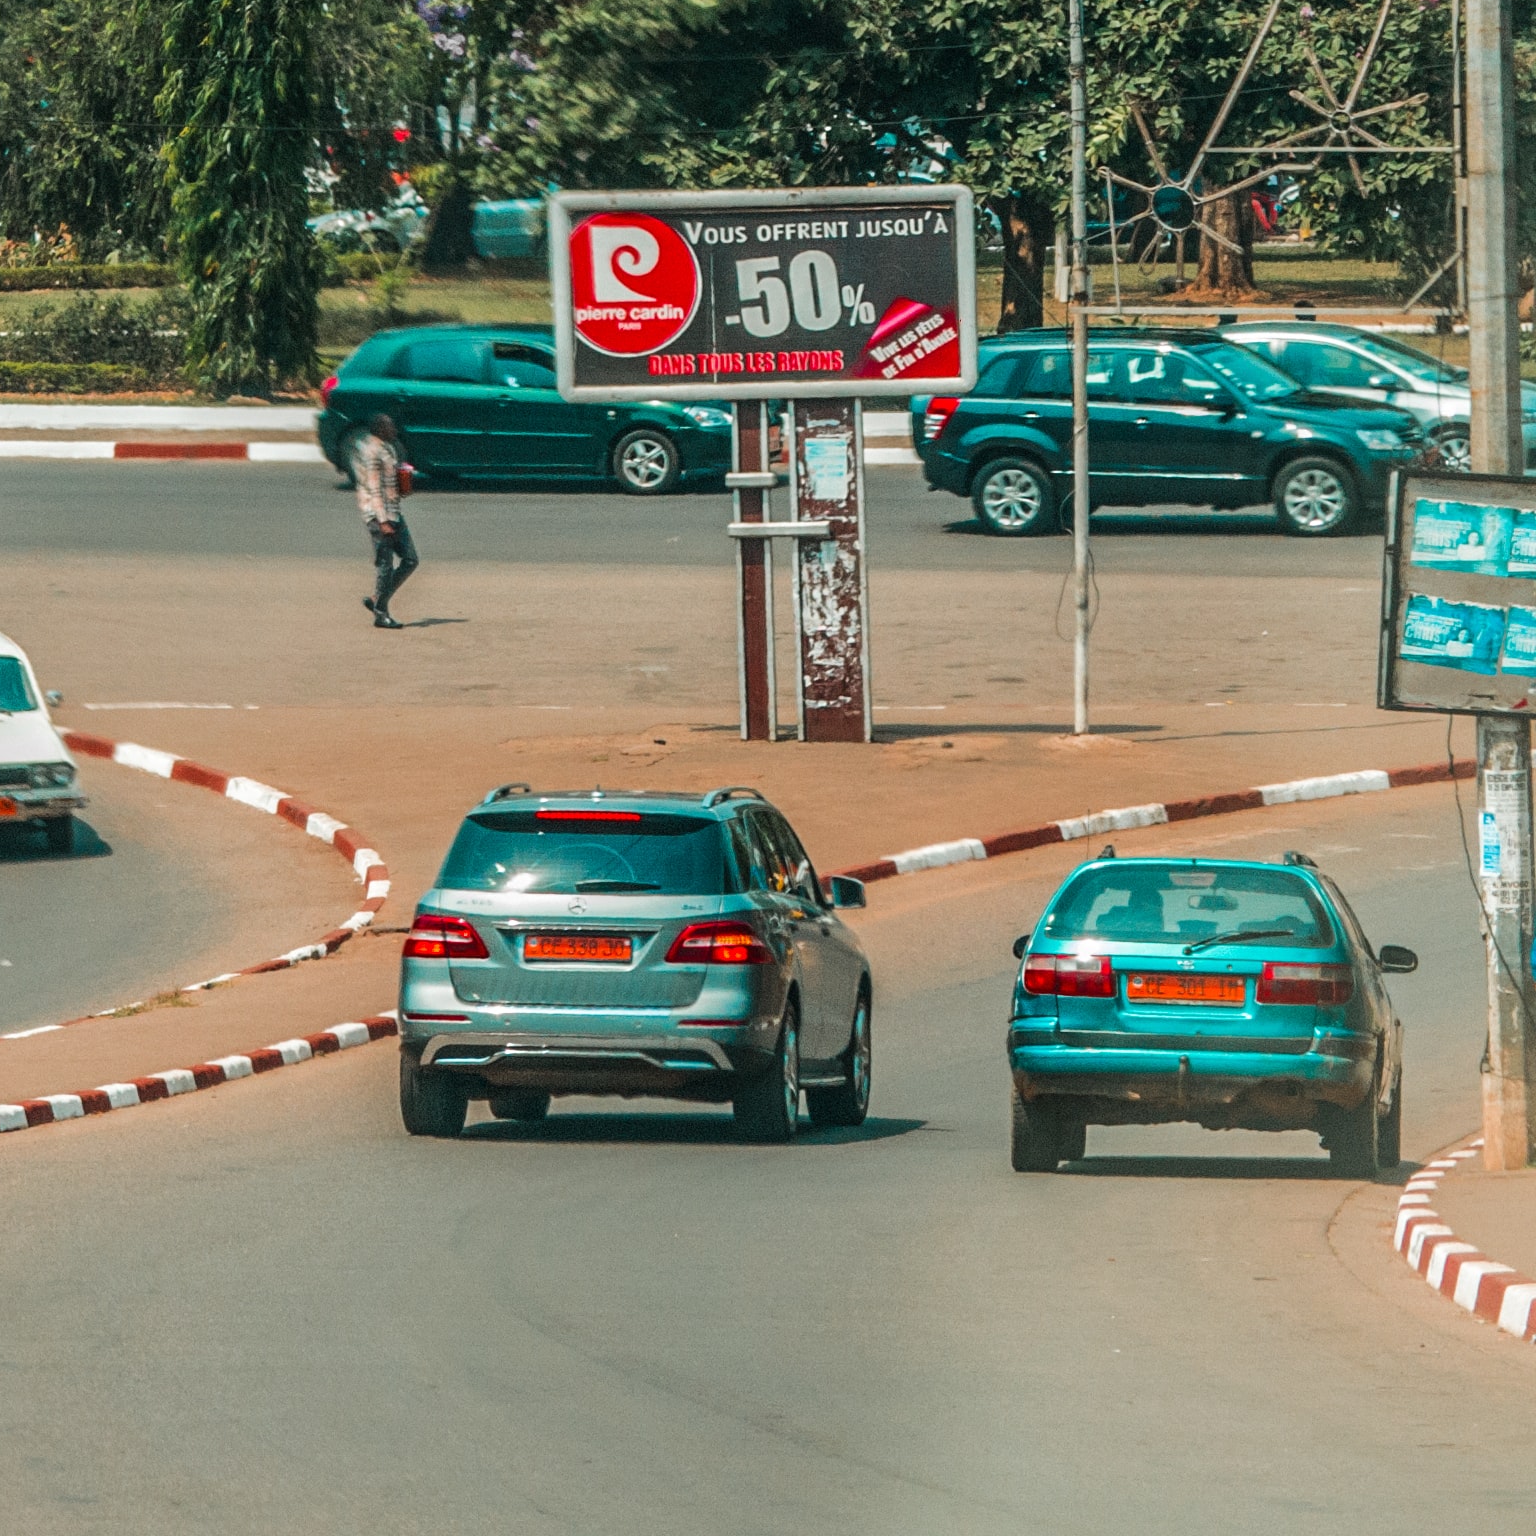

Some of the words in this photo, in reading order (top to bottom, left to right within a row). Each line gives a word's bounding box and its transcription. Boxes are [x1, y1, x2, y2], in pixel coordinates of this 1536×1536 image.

[757, 220, 848, 242] OFFRENT
[576, 306, 626, 324] pierre
[630, 304, 684, 320] cardin
[618, 322, 642, 330] PARIS
[648, 354, 696, 376] DANS
[696, 352, 744, 375] TOUS
[745, 351, 776, 373] LES
[777, 349, 845, 372] RAYONS
[541, 940, 562, 956] CE
[1145, 976, 1165, 994] CE
